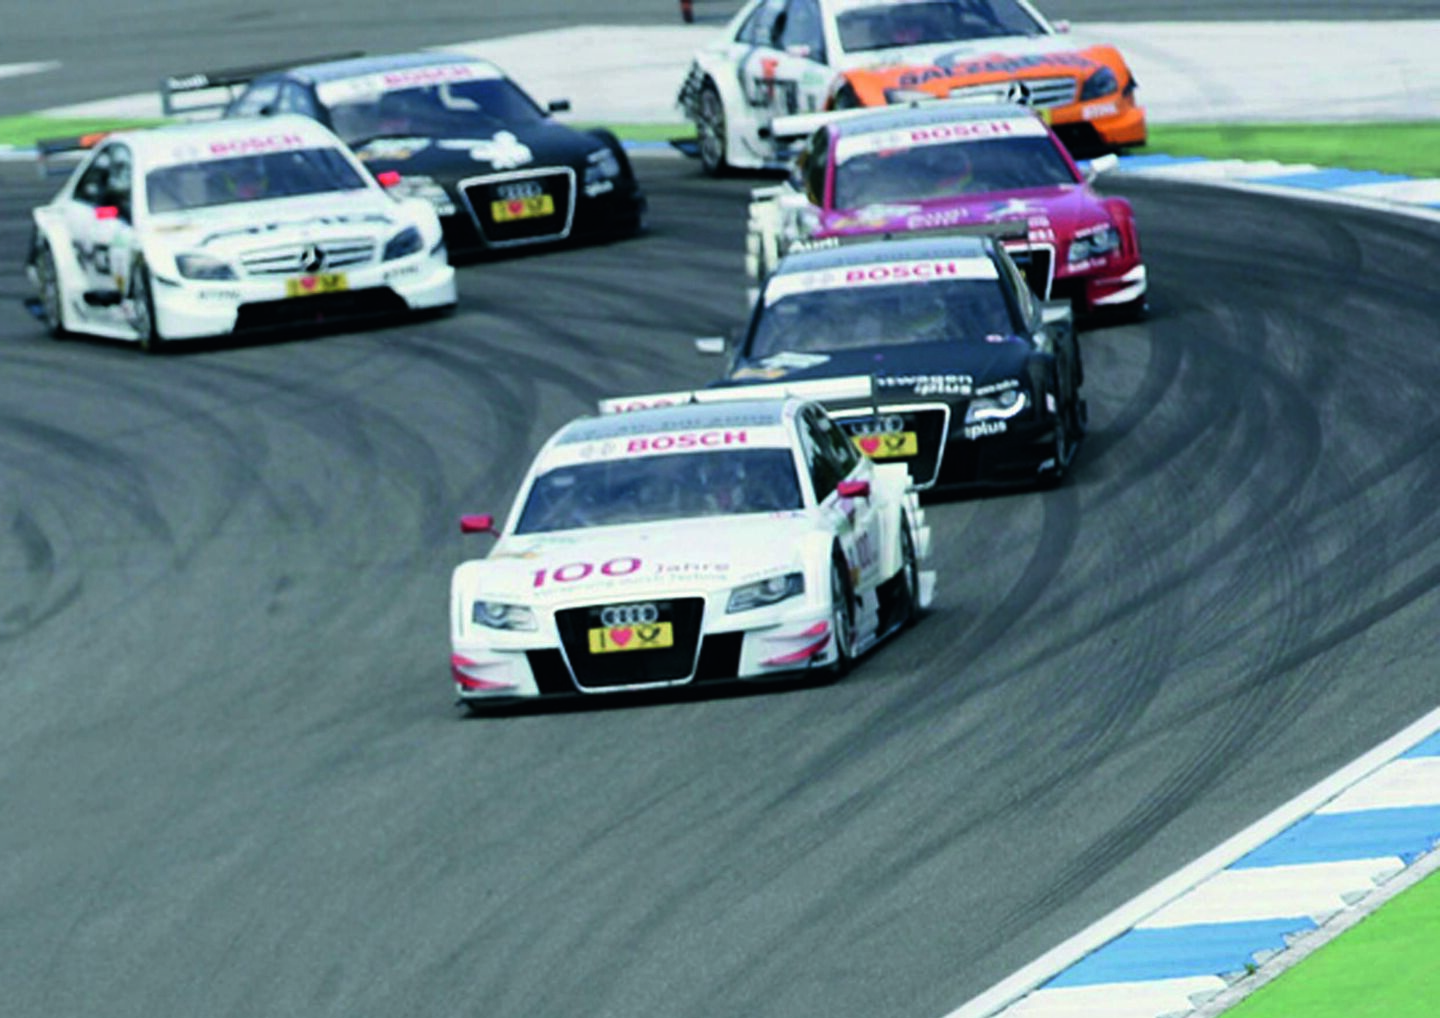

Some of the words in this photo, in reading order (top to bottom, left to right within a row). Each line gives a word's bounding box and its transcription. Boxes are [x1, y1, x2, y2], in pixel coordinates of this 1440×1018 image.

[911, 121, 1012, 142] BOSCH
[846, 261, 957, 283] BOSCH
[626, 430, 748, 452] BOSCH
[533, 557, 642, 588] 100
